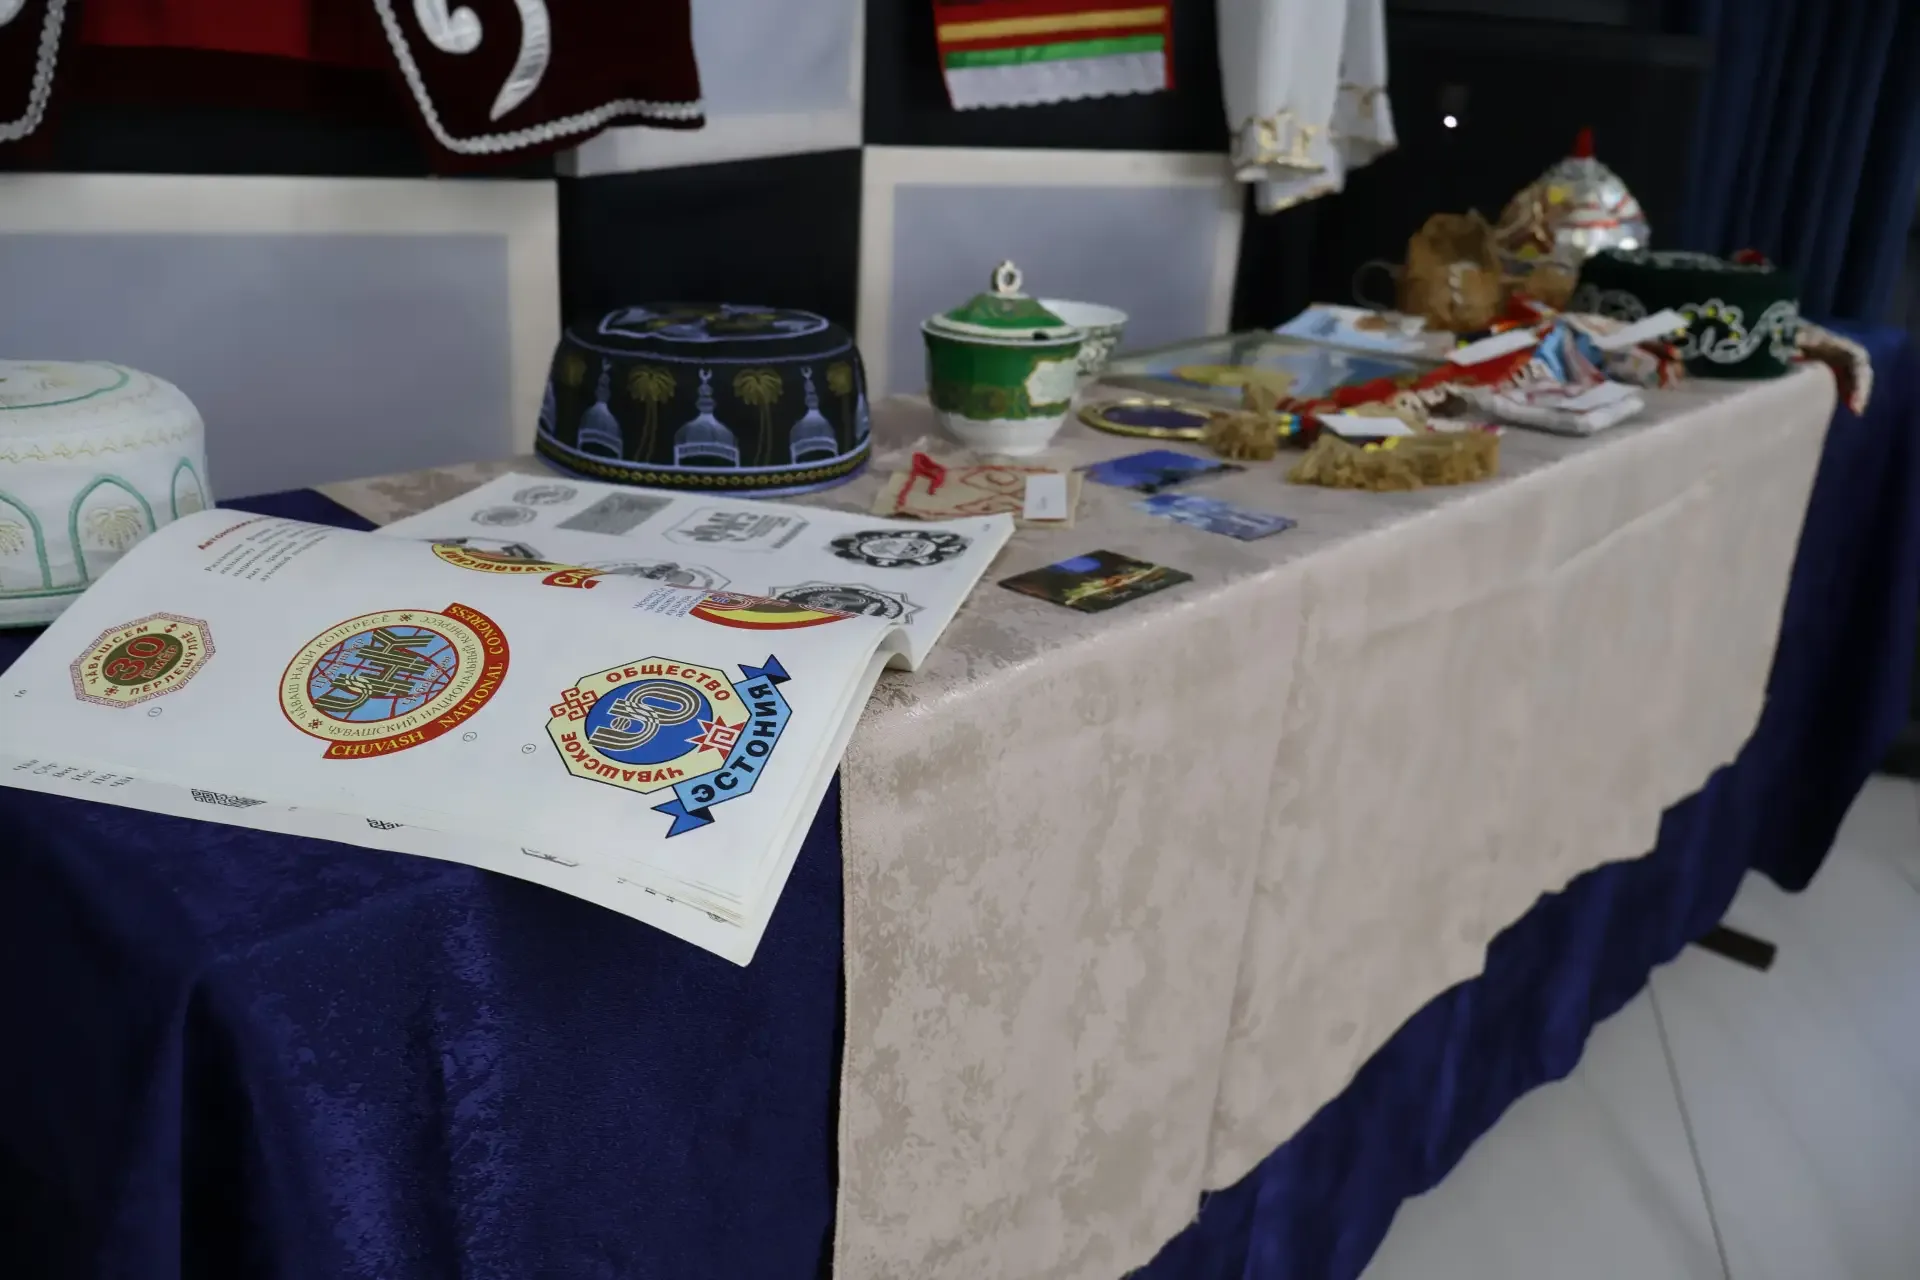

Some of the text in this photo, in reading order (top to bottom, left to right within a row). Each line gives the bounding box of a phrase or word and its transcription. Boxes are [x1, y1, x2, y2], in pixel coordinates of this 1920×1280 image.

[105, 636, 166, 681] 30
[328, 616, 479, 738] ЧУВАШСКИЙ НАЦИОНАЛЬНЫЙ КОНГРЕСС
[330, 605, 504, 756] CHUVASH NATIONAL CONGRESS
[605, 664, 731, 702] ОБЩЕСТВО
[560, 731, 685, 783] ЧУВАШСКОЕ
[691, 683, 778, 804] ЭСТОНИЯ
